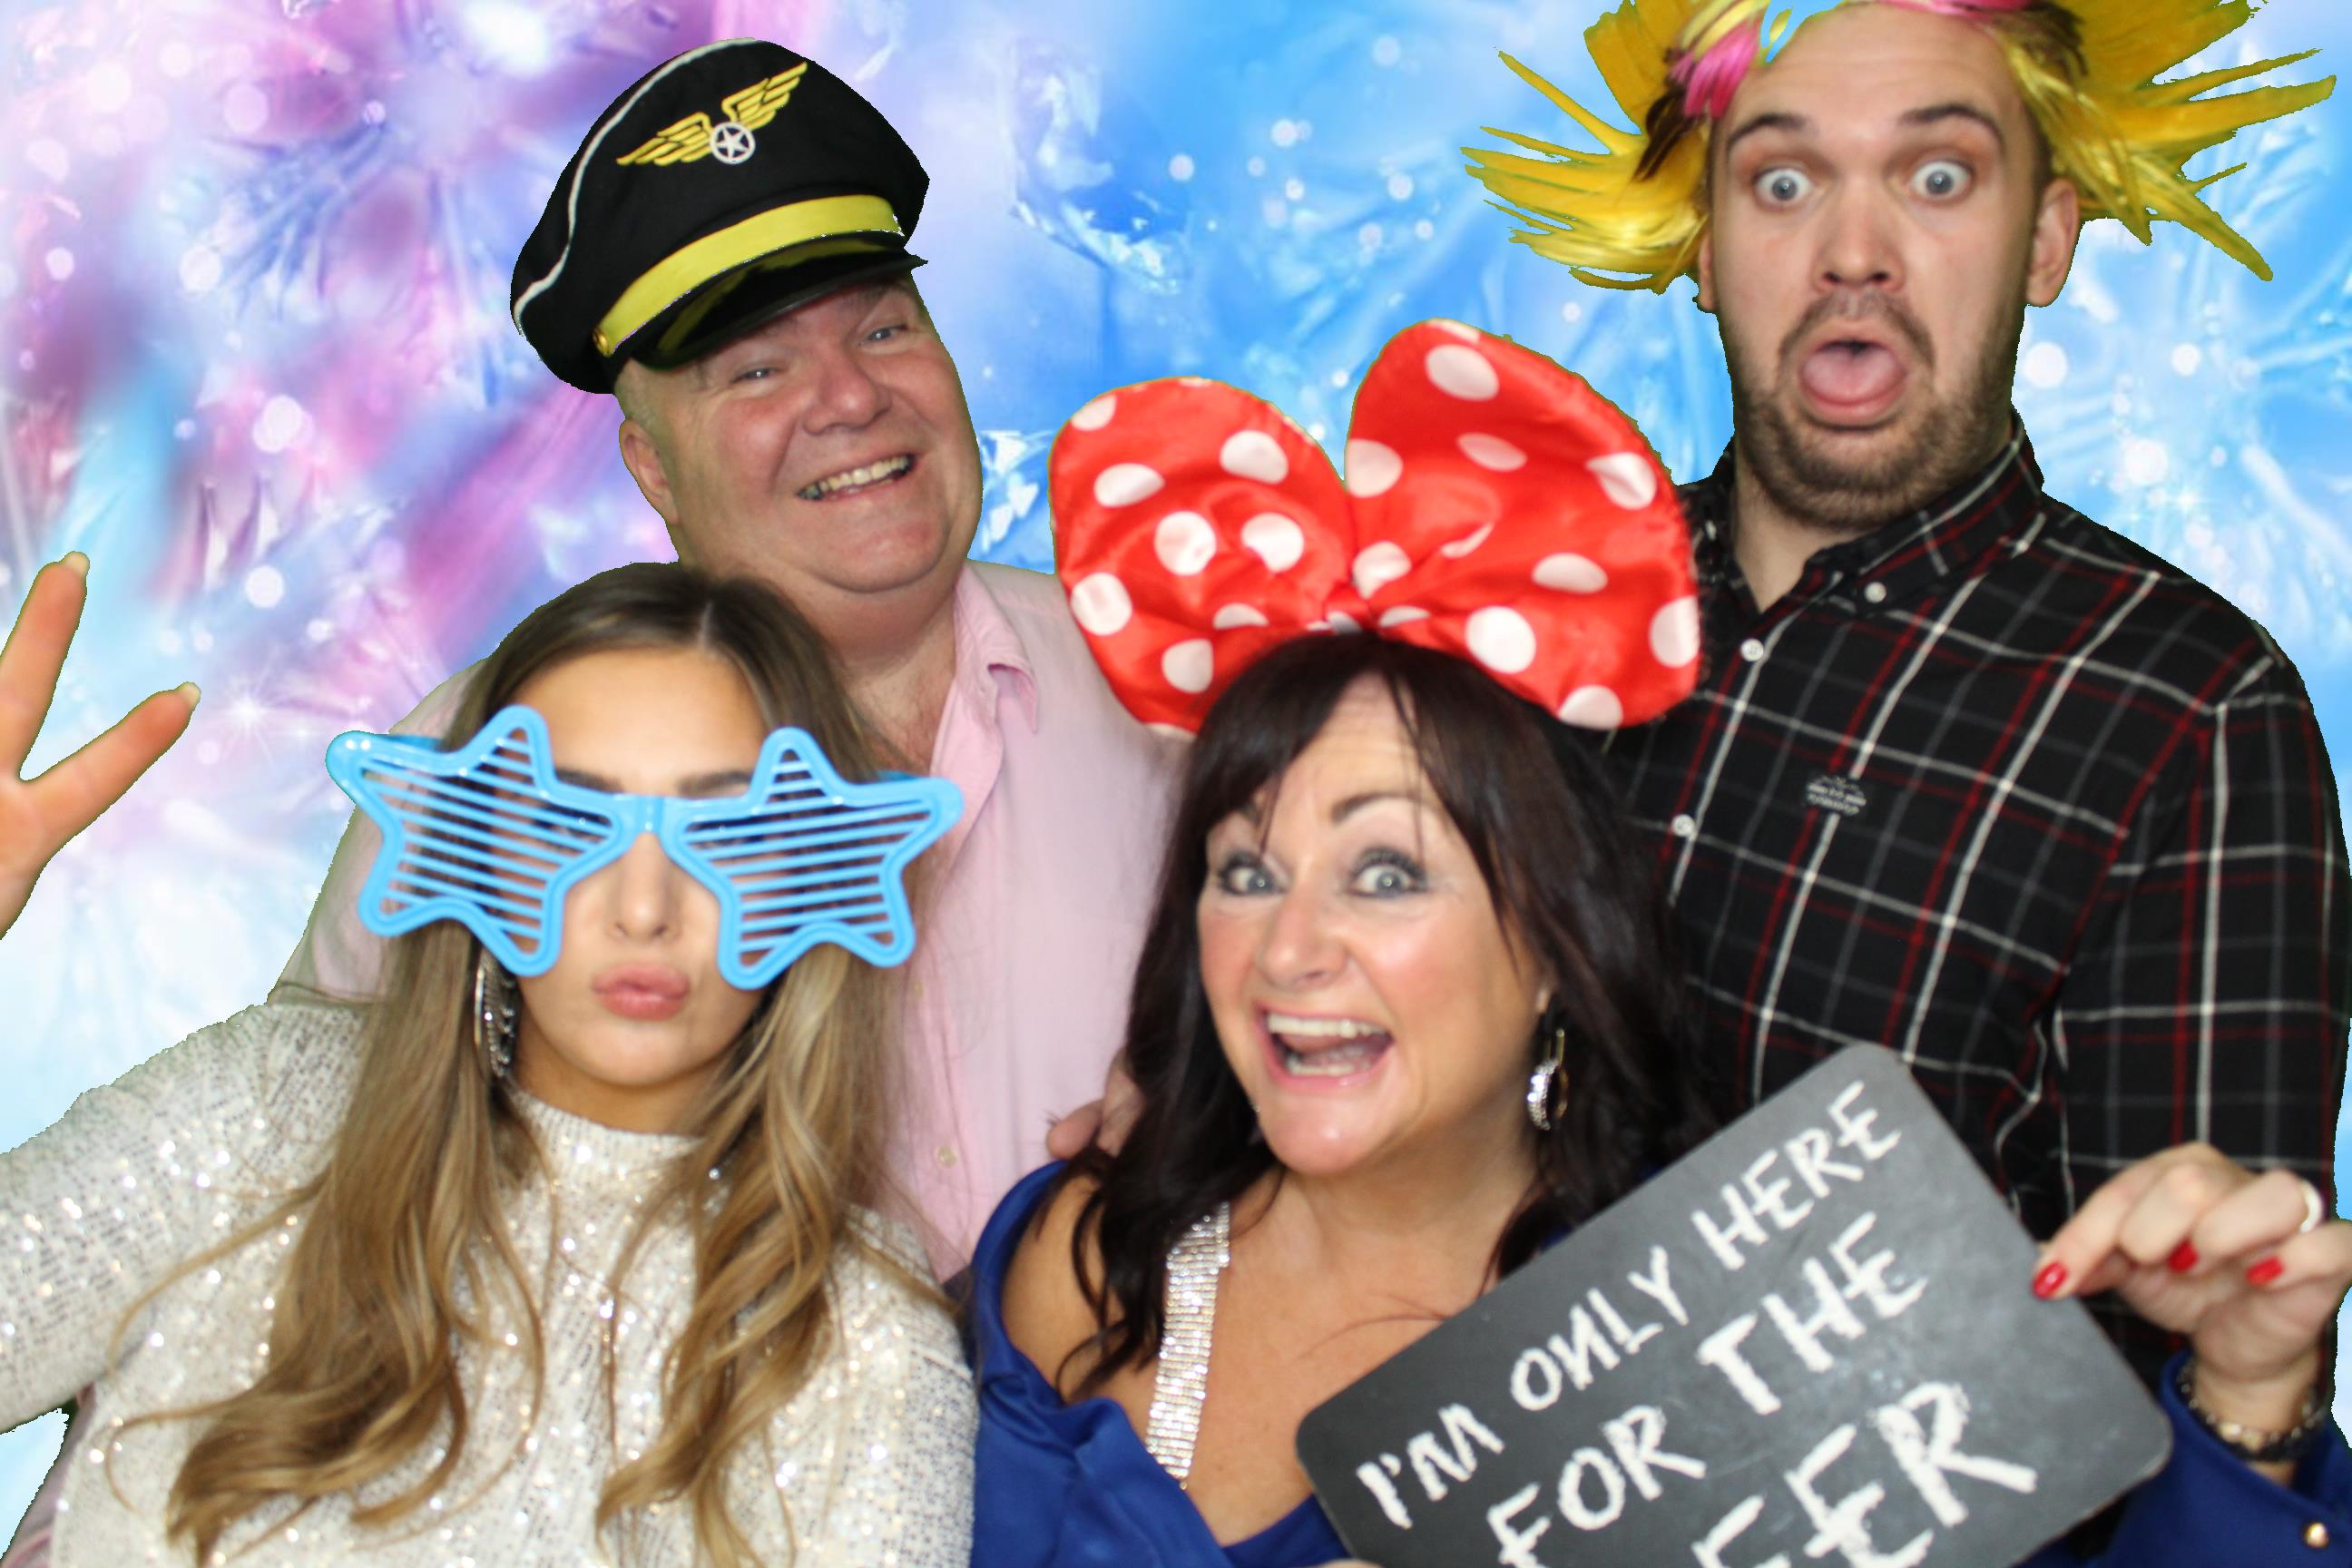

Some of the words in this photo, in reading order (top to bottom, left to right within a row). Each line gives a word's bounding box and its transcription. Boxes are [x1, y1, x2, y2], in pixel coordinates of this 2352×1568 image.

[1356, 1403, 1505, 1530] I'M
[1509, 1243, 1691, 1412] ONLY
[1689, 1078, 1904, 1272] HERE
[1487, 1403, 1707, 1568] FOR
[1695, 1209, 1949, 1416] THE
